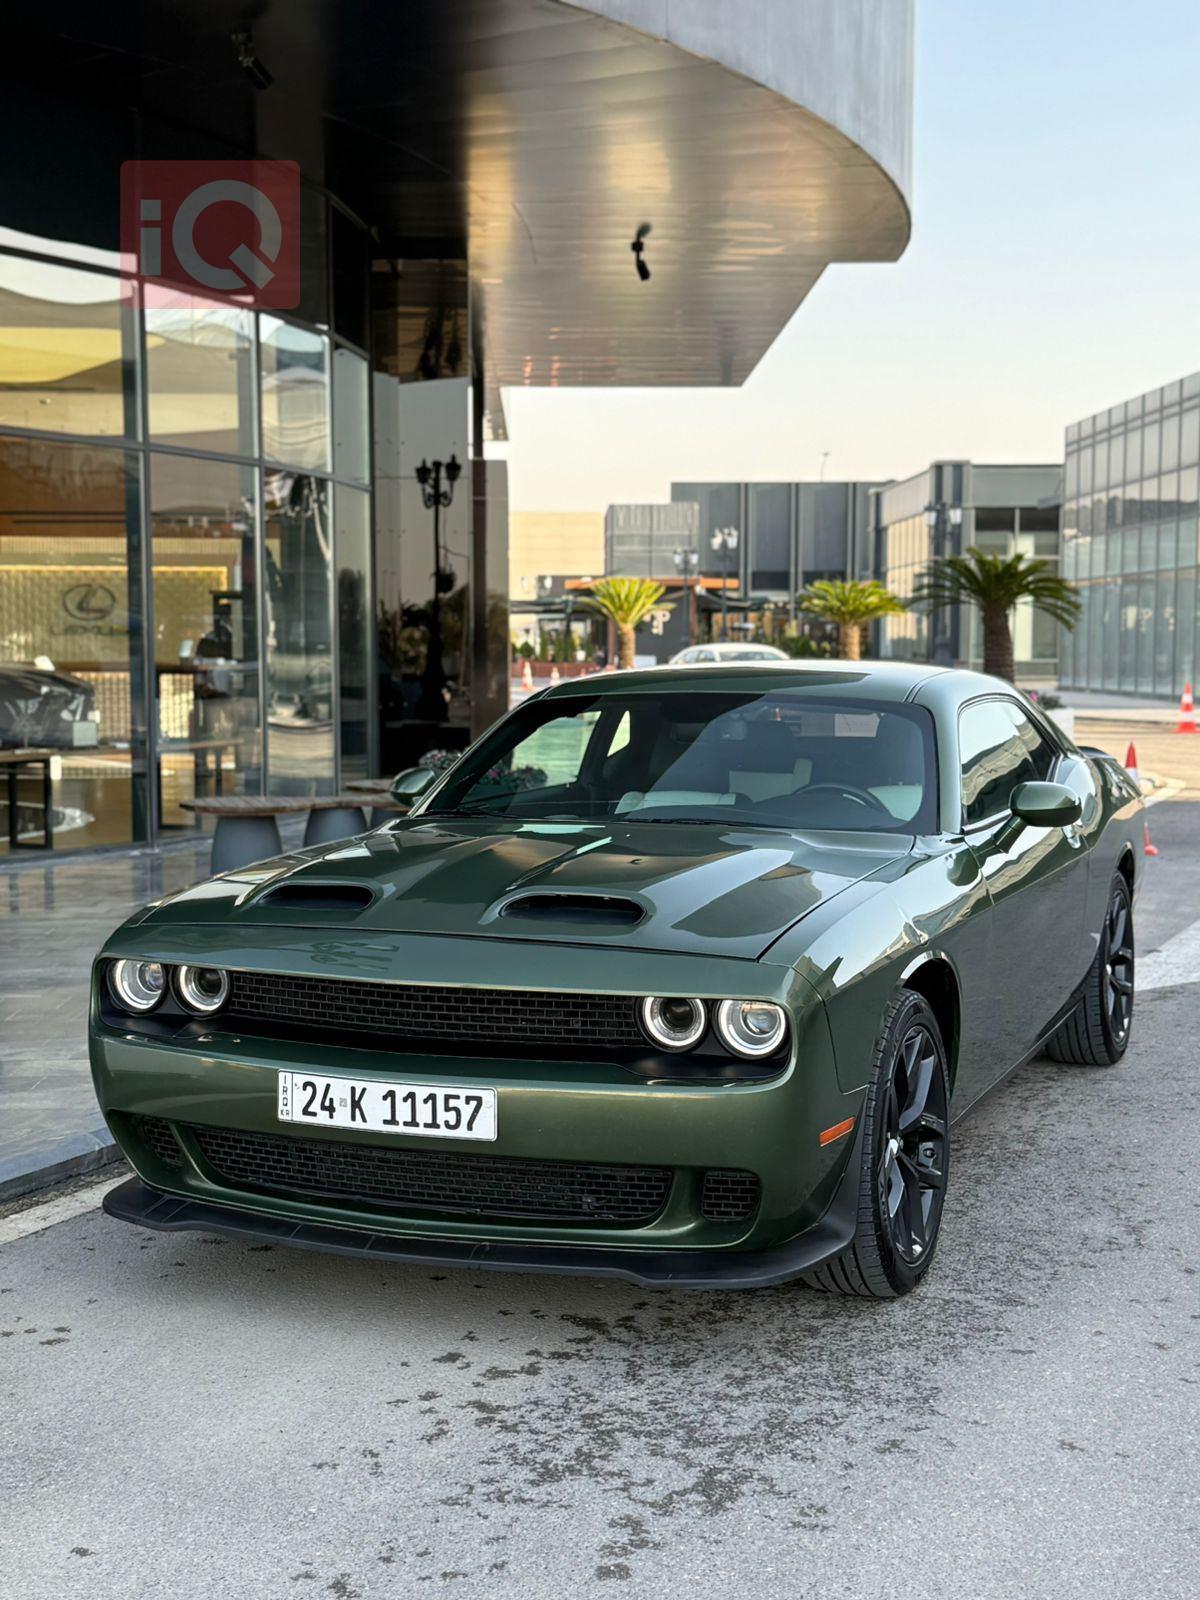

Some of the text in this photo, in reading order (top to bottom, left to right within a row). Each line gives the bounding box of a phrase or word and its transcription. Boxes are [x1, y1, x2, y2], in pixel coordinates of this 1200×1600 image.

[302, 1081, 483, 1131] 24 K 11157
